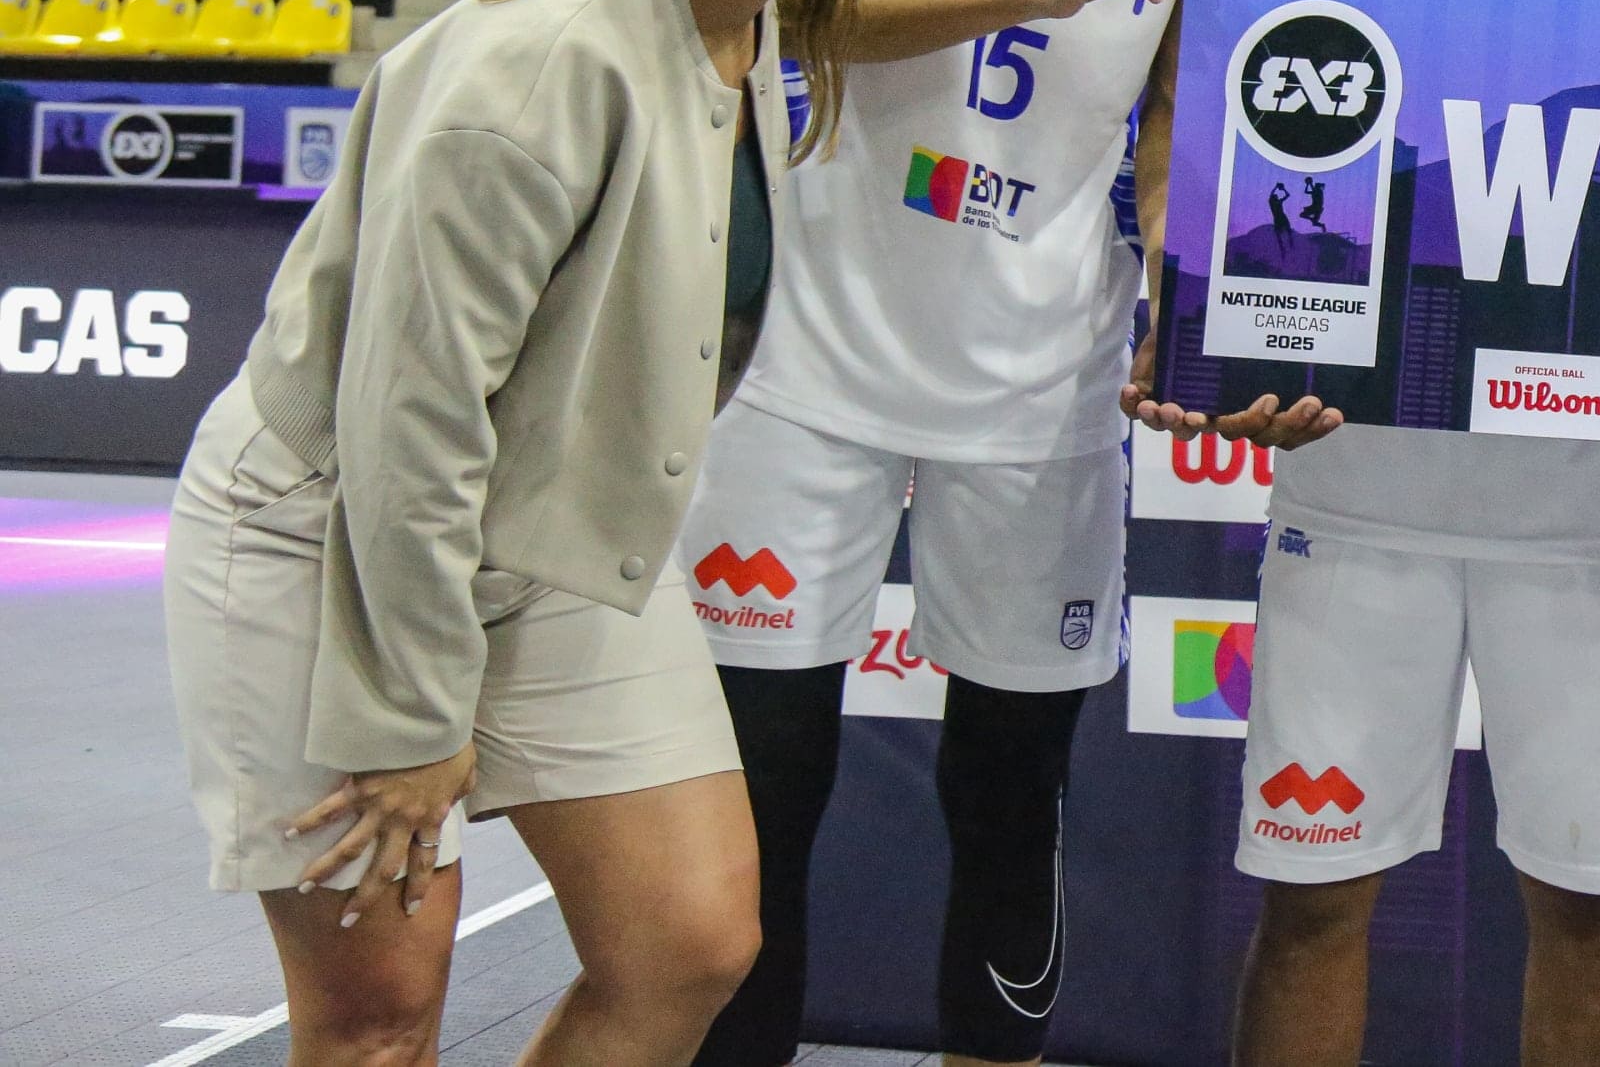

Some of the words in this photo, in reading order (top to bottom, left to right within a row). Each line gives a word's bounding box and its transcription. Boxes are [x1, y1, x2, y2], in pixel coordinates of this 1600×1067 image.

[966, 25, 1050, 121] 15
[968, 163, 1037, 218] BDT
[1221, 291, 1298, 310] NATIONS
[1302, 297, 1366, 315] LEAGUE
[0, 287, 191, 378] CAS
[1255, 313, 1330, 332] CARACAS
[1266, 334, 1314, 351] 2025
[1515, 366, 1560, 377] OFFICIAL
[1562, 369, 1585, 379] BALL
[691, 601, 795, 630] movilnet
[1068, 606, 1090, 617] FVB
[1253, 819, 1362, 845] movilnet
